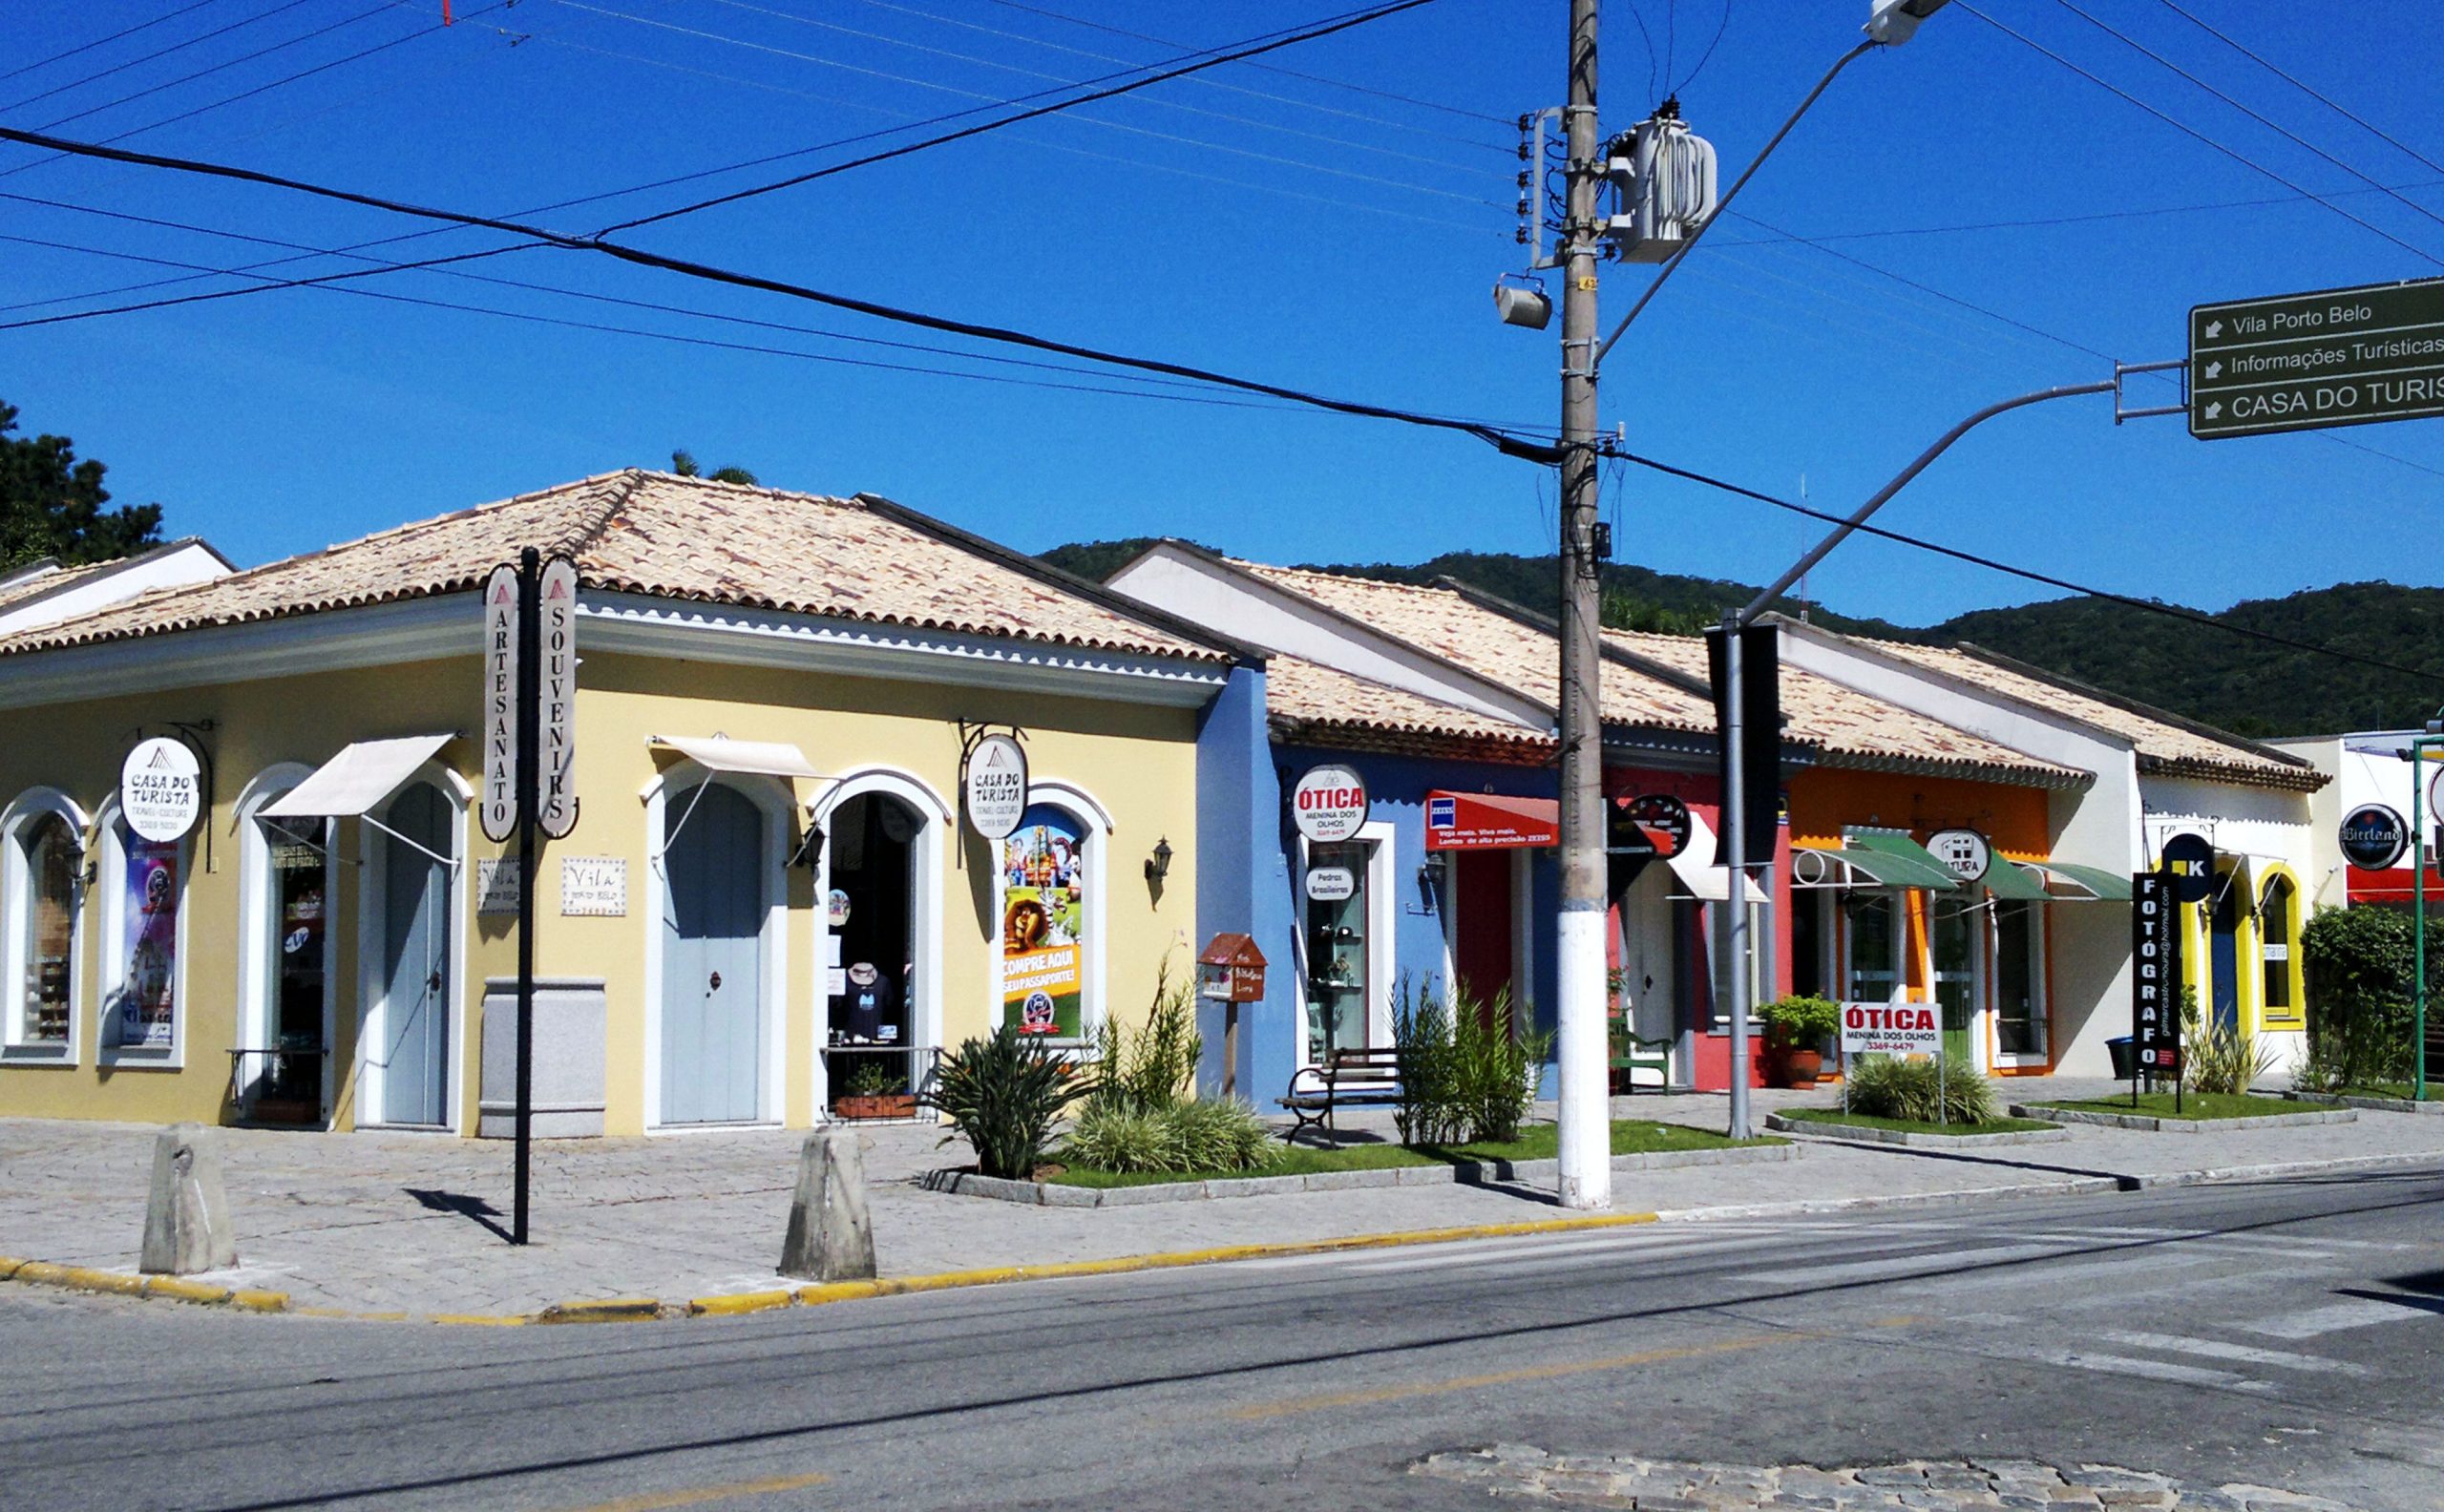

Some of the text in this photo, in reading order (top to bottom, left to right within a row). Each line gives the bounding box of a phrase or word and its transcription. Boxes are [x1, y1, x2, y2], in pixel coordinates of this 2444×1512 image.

[2233, 304, 2371, 334] Vila Porto Belo
[2232, 338, 2444, 373] Informações Turísticas
[2232, 391, 2308, 418] CASA
[2316, 386, 2358, 410] DO
[494, 609, 508, 823] ARTESANATO
[549, 606, 565, 820] SOUVENIRS
[132, 774, 190, 789] CASA DO
[975, 773, 1020, 788] CASA DO
[132, 790, 190, 806] TURISTA
[976, 788, 1020, 803] TURISTA
[1298, 787, 1364, 810] ÓTICA
[1306, 810, 1357, 820] MENINA DOS
[2340, 827, 2401, 841] Bierland
[1945, 861, 1979, 872] TURA
[2188, 860, 2205, 876] K
[482, 868, 516, 886] Vila
[570, 868, 615, 887] Vila
[1317, 872, 1342, 882] Pedras
[1312, 885, 1349, 894] Brasileiras
[1003, 950, 1073, 976] COMPRE AQUI
[2141, 879, 2156, 1063] FOTÓGRAFO
[1003, 978, 1020, 993] SEU
[1845, 1004, 1935, 1030] ÓTICA
[1846, 1031, 1936, 1041] MENINA DOS OLHOS
[1867, 1041, 1915, 1050] 3369-6479
